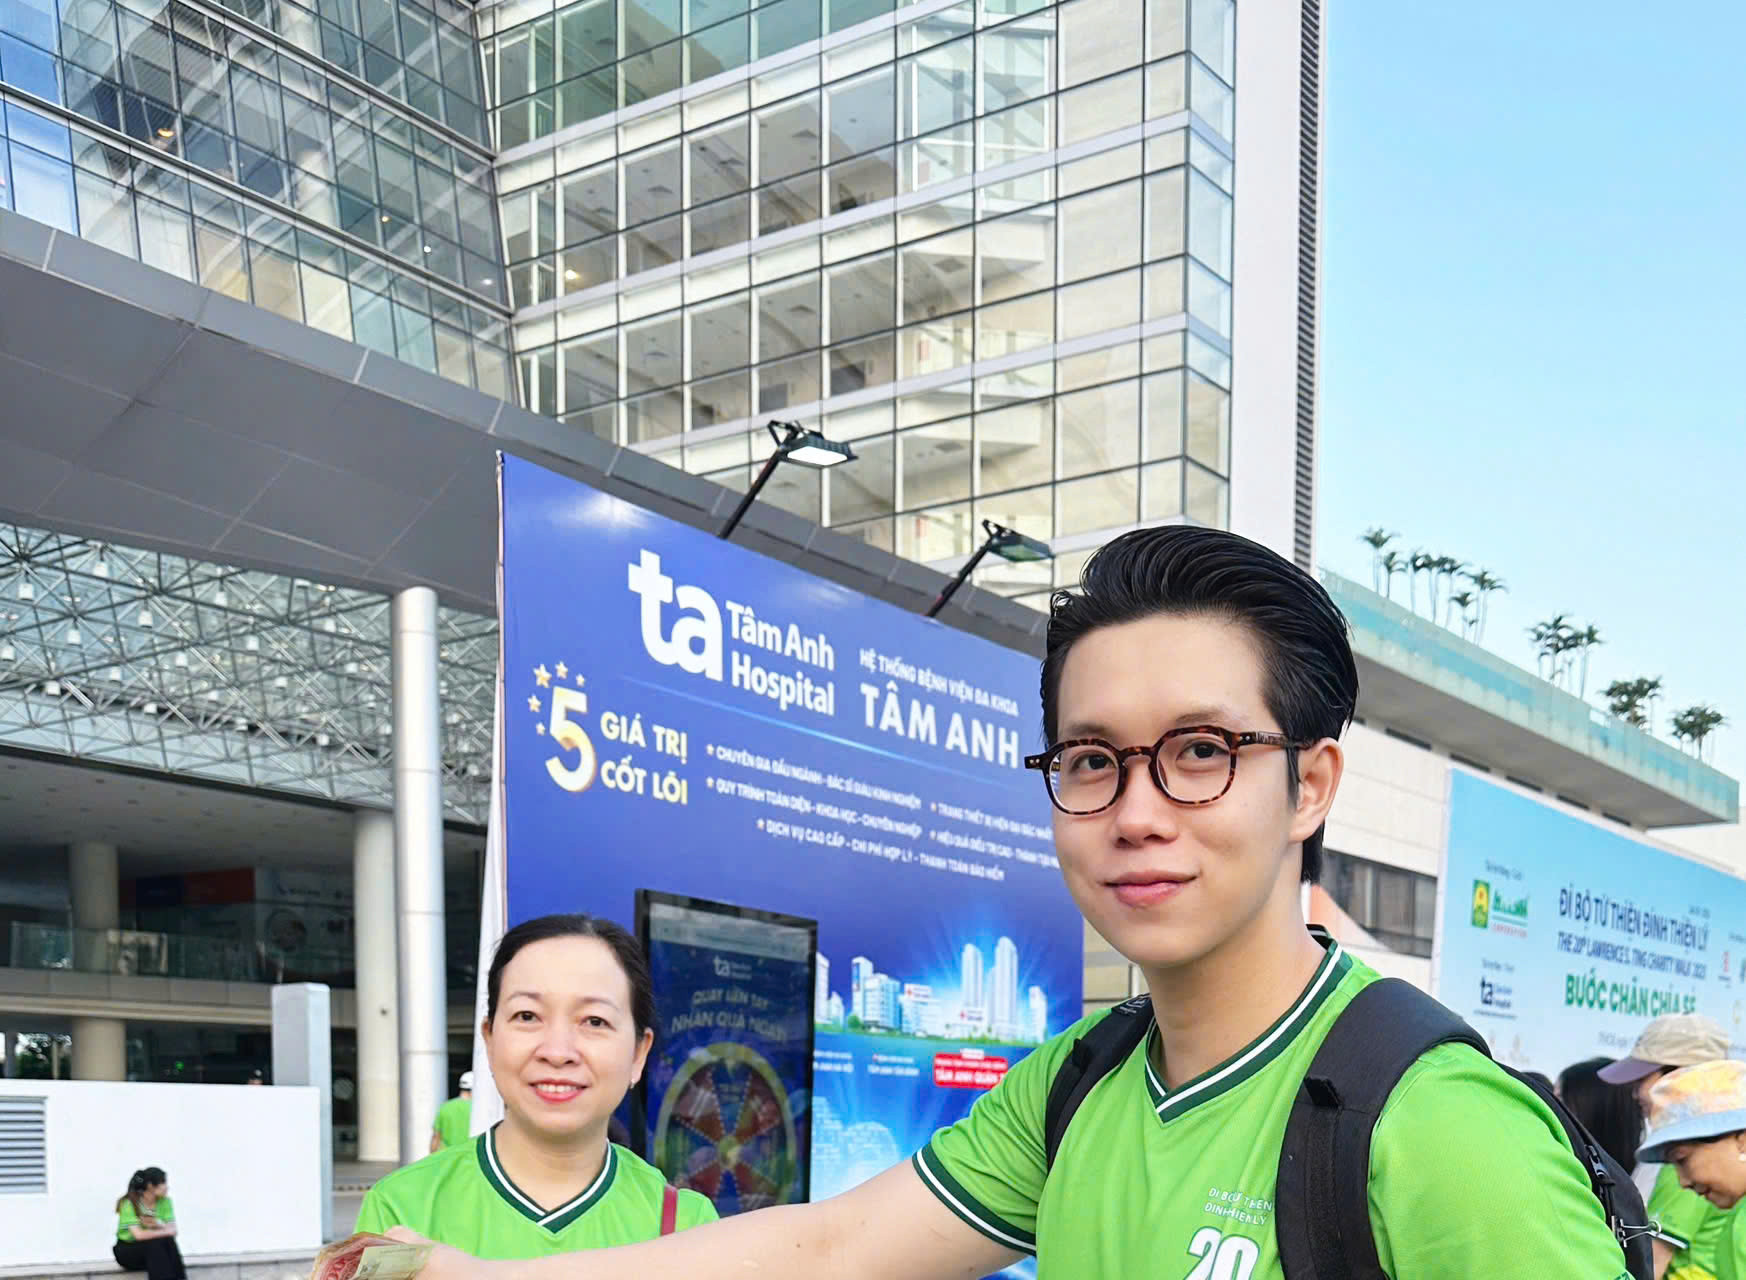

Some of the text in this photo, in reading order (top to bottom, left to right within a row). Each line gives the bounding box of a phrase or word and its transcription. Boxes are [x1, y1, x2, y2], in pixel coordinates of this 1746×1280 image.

[628, 548, 723, 682] ta
[725, 600, 835, 671] Tâm Anh
[731, 650, 835, 716] Hospital
[860, 648, 876, 673] HỆ
[877, 654, 917, 683] THỐNG
[917, 668, 948, 693] BỆNH
[949, 680, 974, 703] VIỆN
[990, 694, 1019, 717] KHOA
[545, 686, 597, 792] 5
[600, 711, 688, 765] GIÁ TRỊ
[860, 680, 1019, 769] TÂM ANH
[600, 754, 688, 805] CỐT LÕI
[716, 778, 736, 795] QUY
[766, 820, 790, 838] DỊCH
[791, 825, 804, 843] VỤ
[805, 828, 825, 844] CAO
[826, 831, 845, 848] CẤP
[1566, 968, 1607, 1009] BƯỚC
[1610, 976, 1648, 1016] CHÂN
